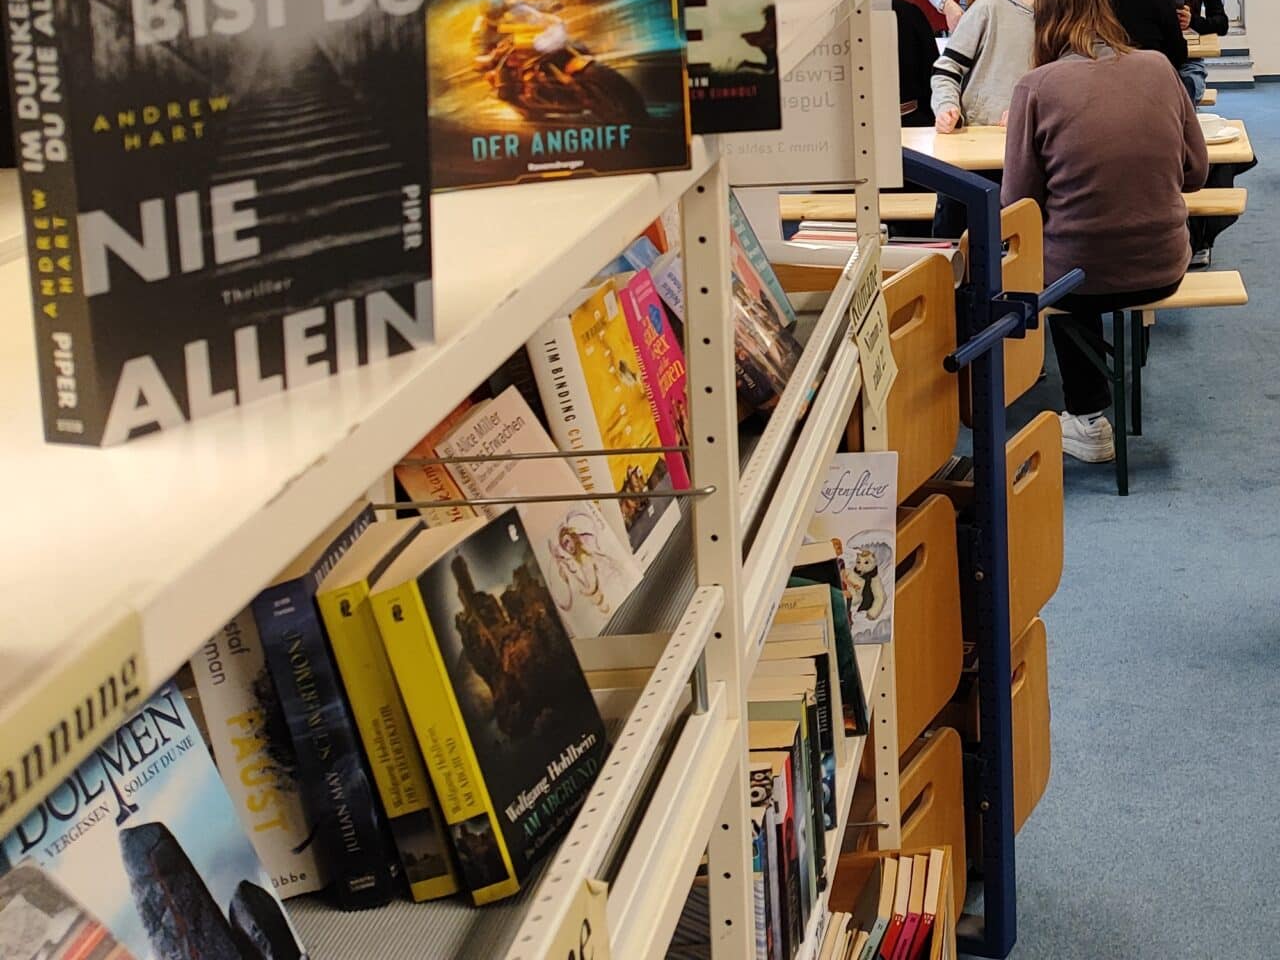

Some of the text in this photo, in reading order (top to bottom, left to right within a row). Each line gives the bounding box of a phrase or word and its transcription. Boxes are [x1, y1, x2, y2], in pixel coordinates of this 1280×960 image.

[36, 46, 63, 103] NIE
[42, 113, 68, 163] DU
[92, 95, 231, 132] ANDREW
[124, 121, 206, 151] HART
[20, 130, 45, 173] IM
[472, 124, 633, 162] DER ANGRIFF
[76, 179, 260, 297] NIE
[399, 183, 422, 253] PIPER
[31, 189, 74, 319] ANDREW HART
[221, 276, 293, 307] Thriller
[51, 331, 77, 409] PIPER
[100, 280, 434, 448] ALLEIN
[542, 337, 560, 365] TIM
[550, 367, 577, 423] BINDING
[456, 410, 500, 454] Alice Miller
[16, 689, 187, 855] DOLMEN
[124, 734, 195, 797] SOLLST DU NIE
[225, 710, 289, 833] FAUST
[325, 771, 352, 809] MAY
[504, 731, 597, 825] Wolfgang Hohlbein
[44, 801, 111, 859] VERGESSEN
